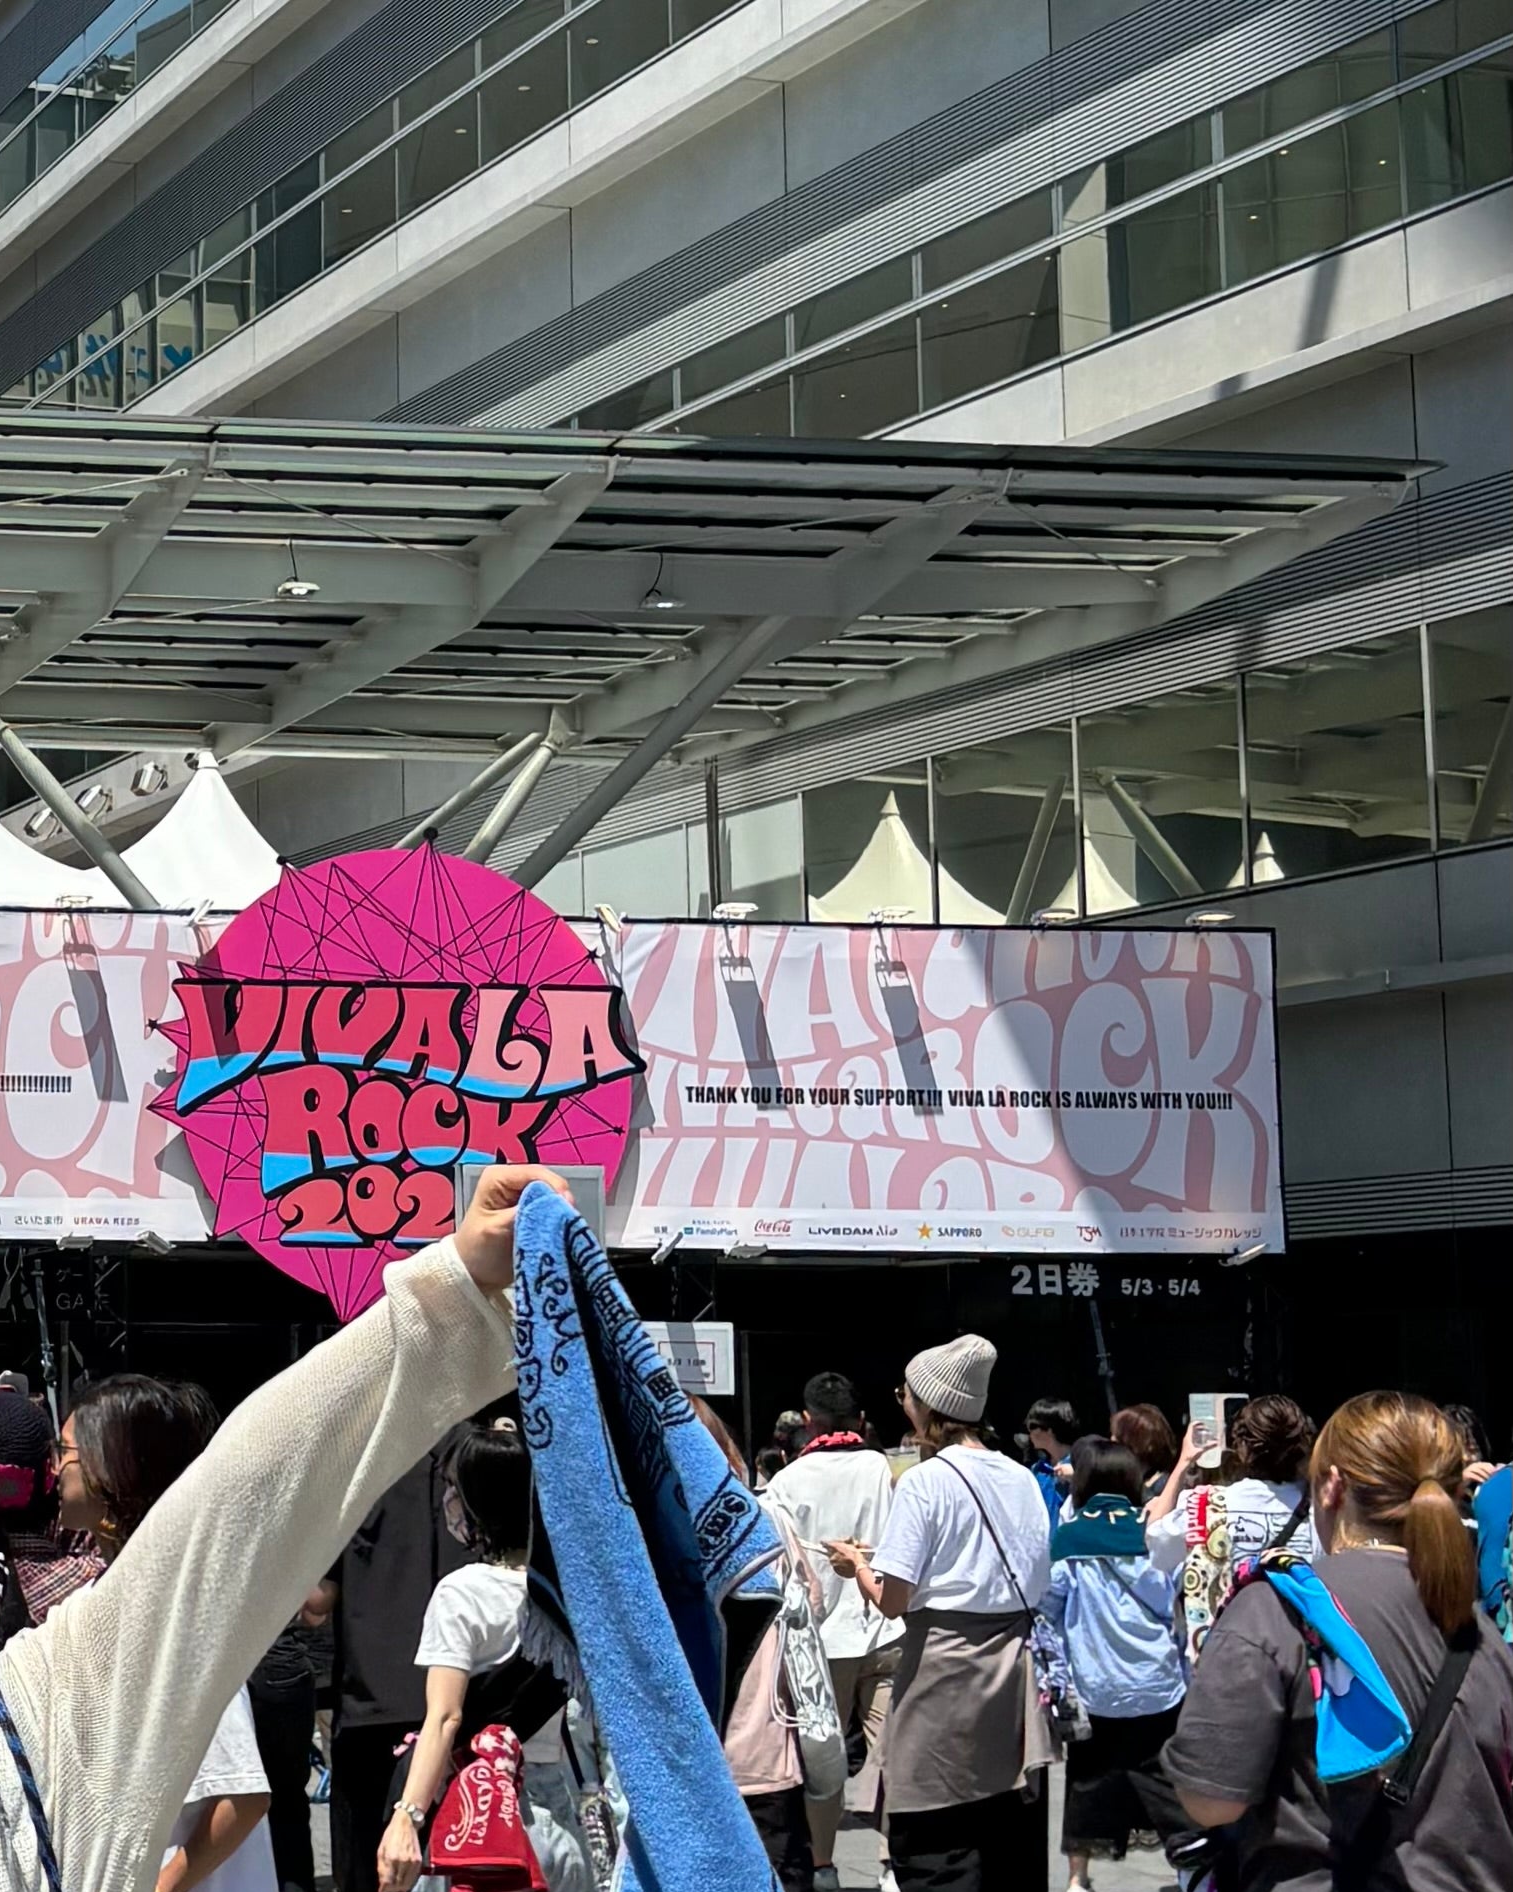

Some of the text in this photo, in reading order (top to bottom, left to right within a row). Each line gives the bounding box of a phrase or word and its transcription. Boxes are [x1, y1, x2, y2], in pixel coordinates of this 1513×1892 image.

[686, 1086, 1233, 1110] THANK YOU FOR YOUR SUPPORT!!! VIVA LA ROCK IS ALWAYS WITH YOU!!!
[258, 1062, 559, 1199] ROCK
[276, 1163, 456, 1247] 202
[937, 1227, 982, 1238] SAPPORO
[1011, 1263, 1100, 1297] 2日券
